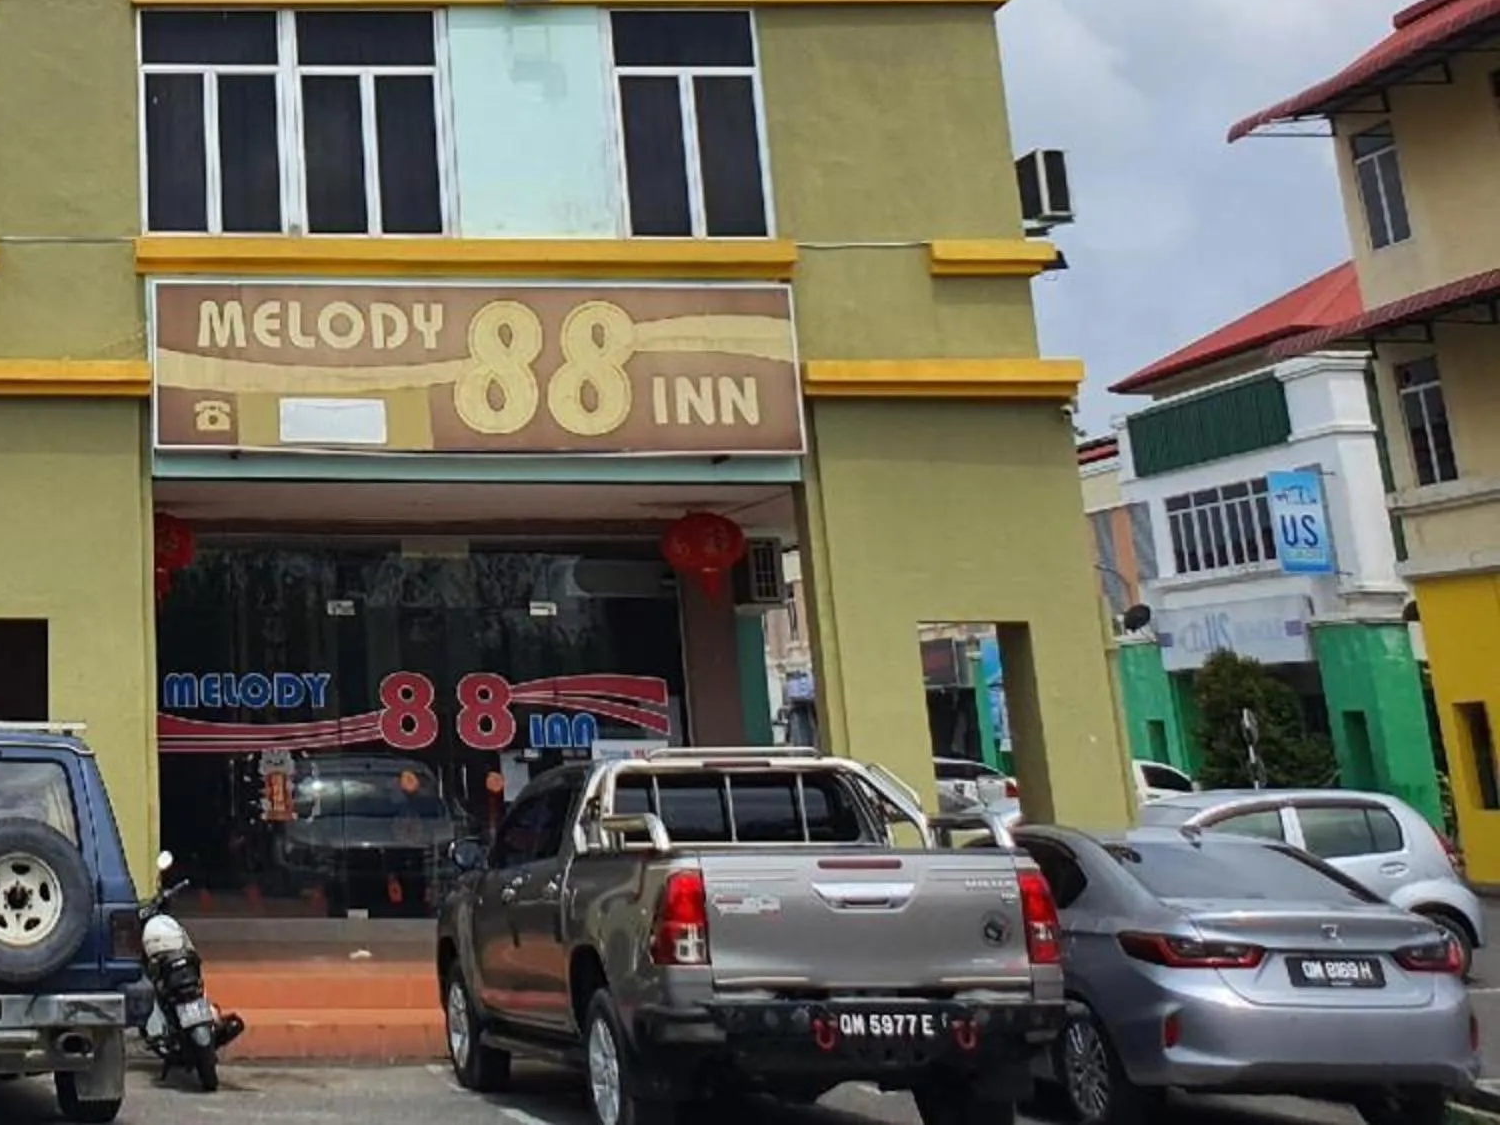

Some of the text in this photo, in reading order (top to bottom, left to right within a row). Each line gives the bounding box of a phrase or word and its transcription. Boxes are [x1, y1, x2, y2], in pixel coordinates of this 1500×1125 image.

[196, 299, 761, 435] MELODY 88 INN
[1280, 513, 1319, 549] US
[163, 673, 331, 709] MELODY
[379, 671, 517, 750] 88
[840, 1014, 935, 1036] QM 5977 E
